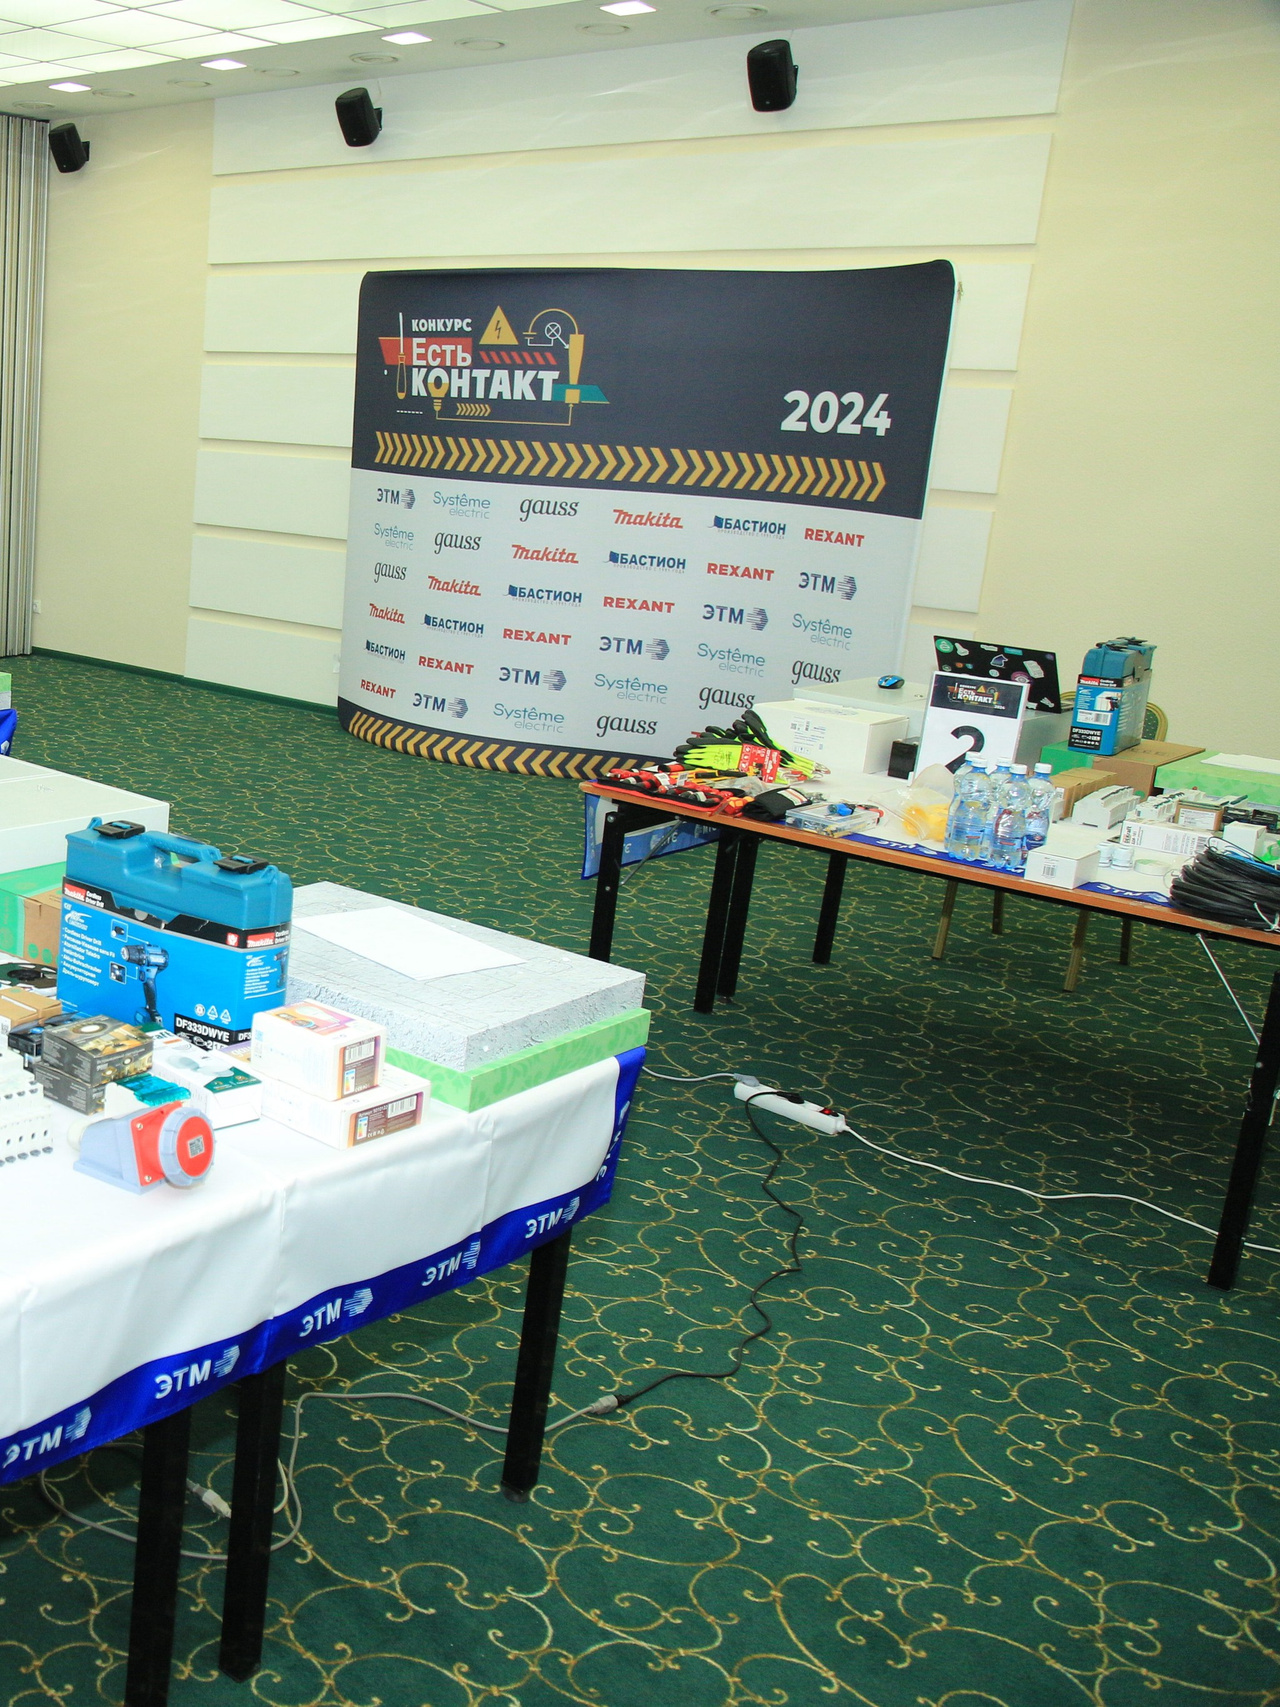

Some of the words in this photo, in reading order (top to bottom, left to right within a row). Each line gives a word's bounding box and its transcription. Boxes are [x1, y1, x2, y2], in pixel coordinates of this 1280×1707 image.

[411, 318, 472, 332] КОНКУРС
[780, 389, 892, 437] 2024
[377, 488, 400, 505] ЭТМ
[449, 507, 490, 519] electric
[520, 498, 579, 522] gauss
[724, 517, 786, 536] БАСТИОН
[385, 538, 414, 551] electric
[434, 532, 482, 554] gauss
[804, 528, 865, 547] REXANT
[620, 553, 686, 570] БАСТИОН
[374, 562, 407, 583] gauss
[707, 562, 775, 581] REXANT
[798, 572, 836, 594] ЭТМ
[518, 587, 582, 604] БАСТИОН
[603, 596, 675, 614] REXANT
[702, 604, 744, 624] ЭТМ
[431, 617, 484, 635] БАСТИОН
[503, 628, 572, 645] REXANT
[599, 636, 643, 655] ЭТМ
[810, 633, 851, 651] electric
[370, 642, 405, 661] БАСТИОН
[418, 656, 474, 675] REXANT
[719, 661, 765, 678] electric
[791, 660, 841, 685] gauss
[499, 667, 541, 686] ЭТМ
[361, 679, 396, 699] REXANT
[617, 690, 667, 705] electric
[699, 686, 756, 710] gauss
[412, 693, 446, 713] ЭТМ
[514, 720, 564, 733] electric
[596, 714, 658, 738] gauss
[945, 725, 985, 774] 2
[175, 1016, 230, 1042] DF333DWYE
[525, 1207, 563, 1239] ЭТМ
[422, 1252, 464, 1287] ЭТМ
[298, 1298, 343, 1338] ЭТМ
[154, 1359, 212, 1400] ЭТМ
[4, 1425, 63, 1469] ЭТМ
